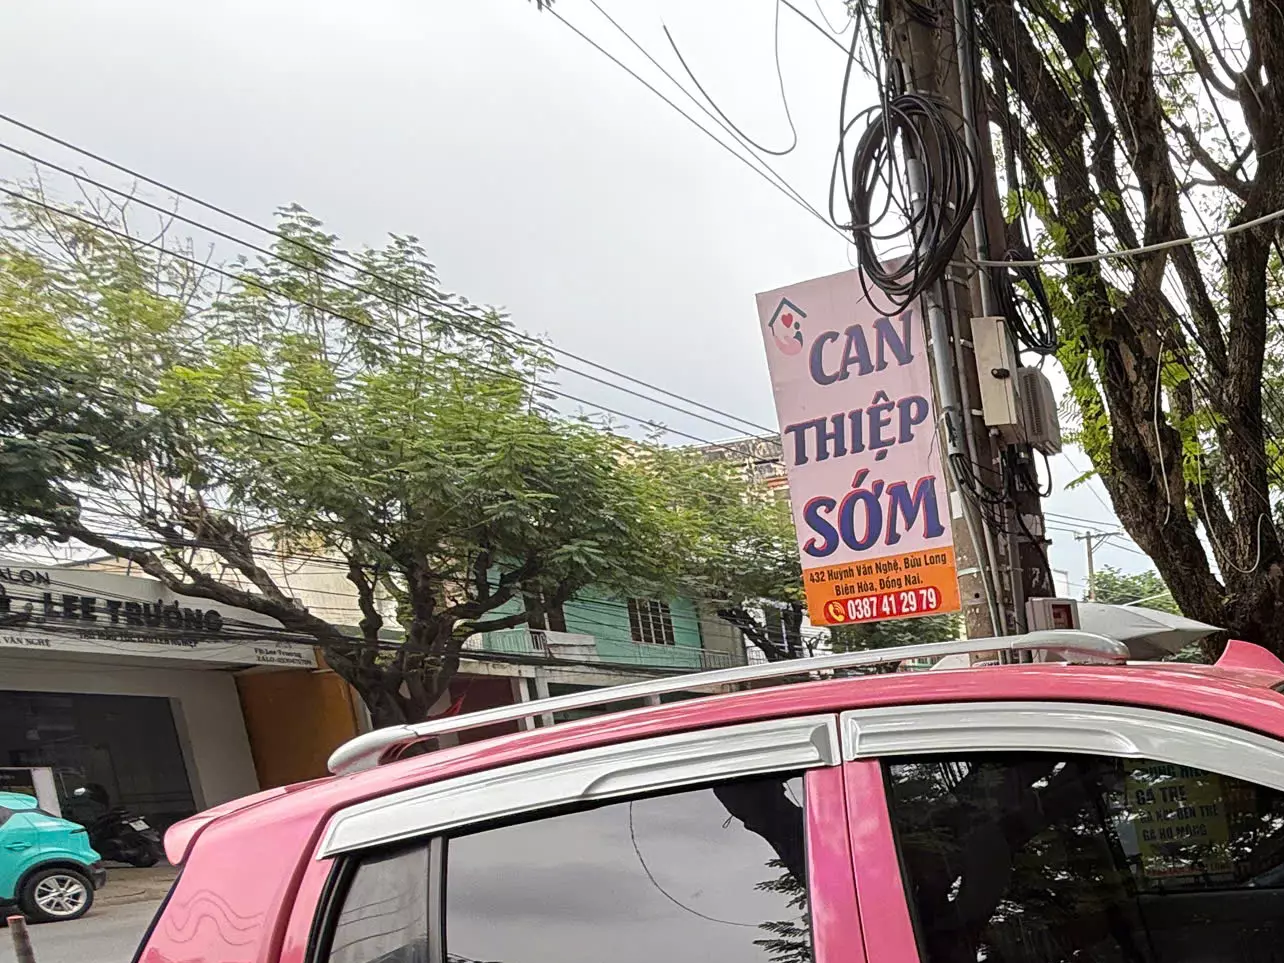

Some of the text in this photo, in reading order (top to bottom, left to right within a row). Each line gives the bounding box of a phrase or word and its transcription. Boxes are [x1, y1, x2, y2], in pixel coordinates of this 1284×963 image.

[809, 309, 914, 386] CAN
[784, 390, 929, 465] THIỆP
[802, 469, 945, 558] SỚM
[0, 568, 50, 584] ALON
[810, 571, 826, 583] 432
[828, 568, 854, 581] Huỳnh
[856, 565, 873, 577] Văn
[875, 562, 902, 574] Nghệ,
[924, 553, 946, 567] Long
[835, 582, 855, 596] Biên
[857, 579, 878, 593] Hòa,
[904, 574, 924, 586] Nai.
[44, 592, 97, 621] LEE
[847, 588, 937, 620] 0387 41 29 79
